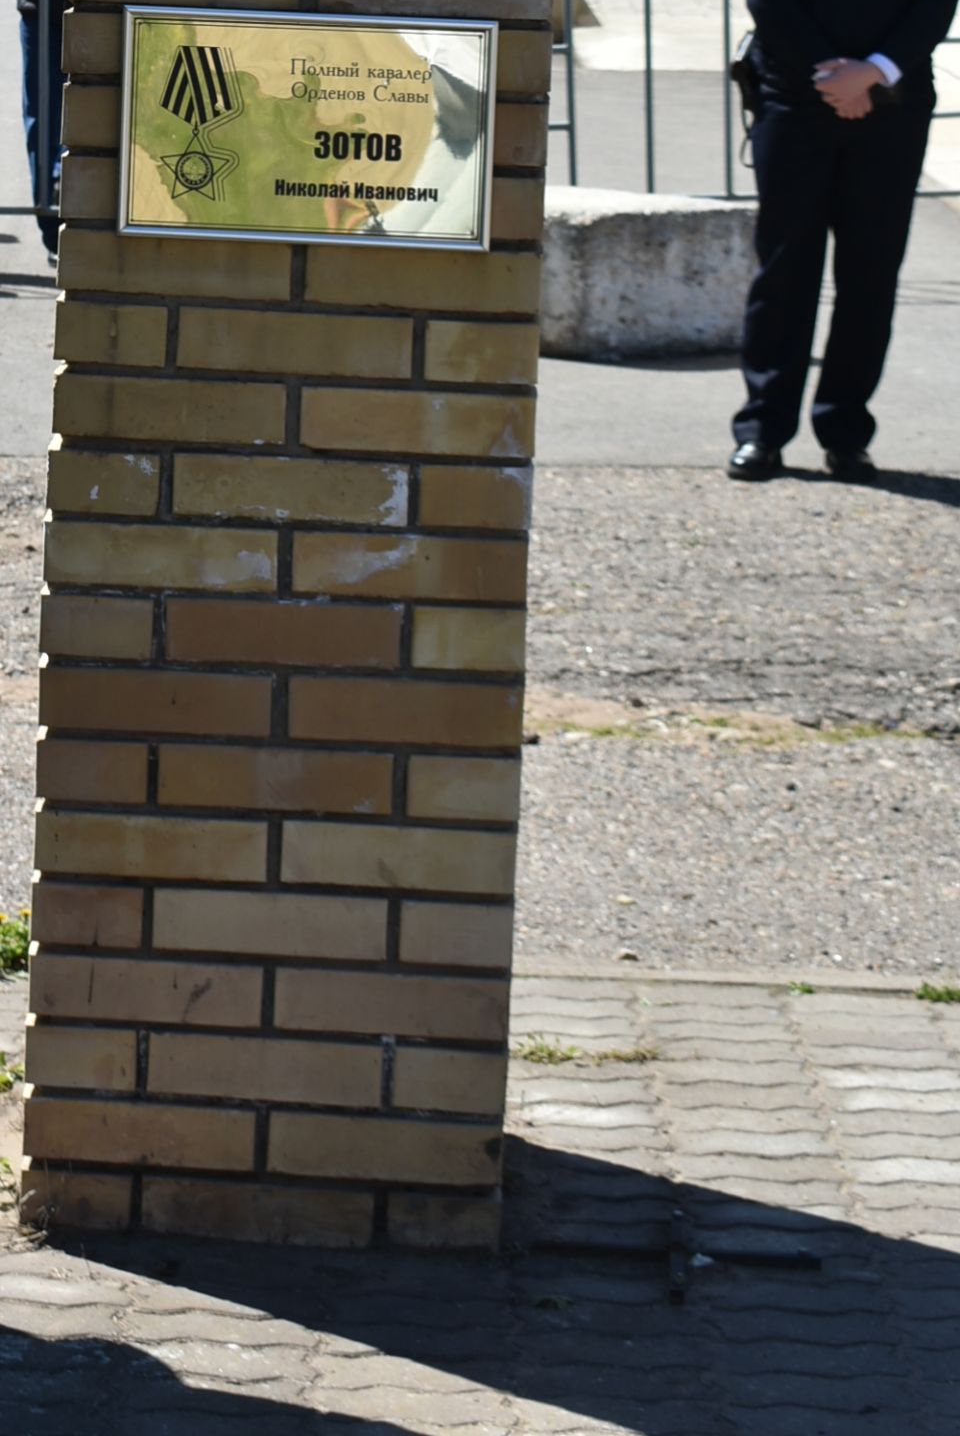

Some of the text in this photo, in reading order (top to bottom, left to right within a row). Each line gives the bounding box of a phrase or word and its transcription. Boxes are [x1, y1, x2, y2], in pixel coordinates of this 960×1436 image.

[290, 57, 433, 84] Полный кавалер
[291, 81, 430, 104] Орденов Славы
[314, 131, 402, 162] ЗОТОВ
[274, 178, 439, 203] Николай Иванович
